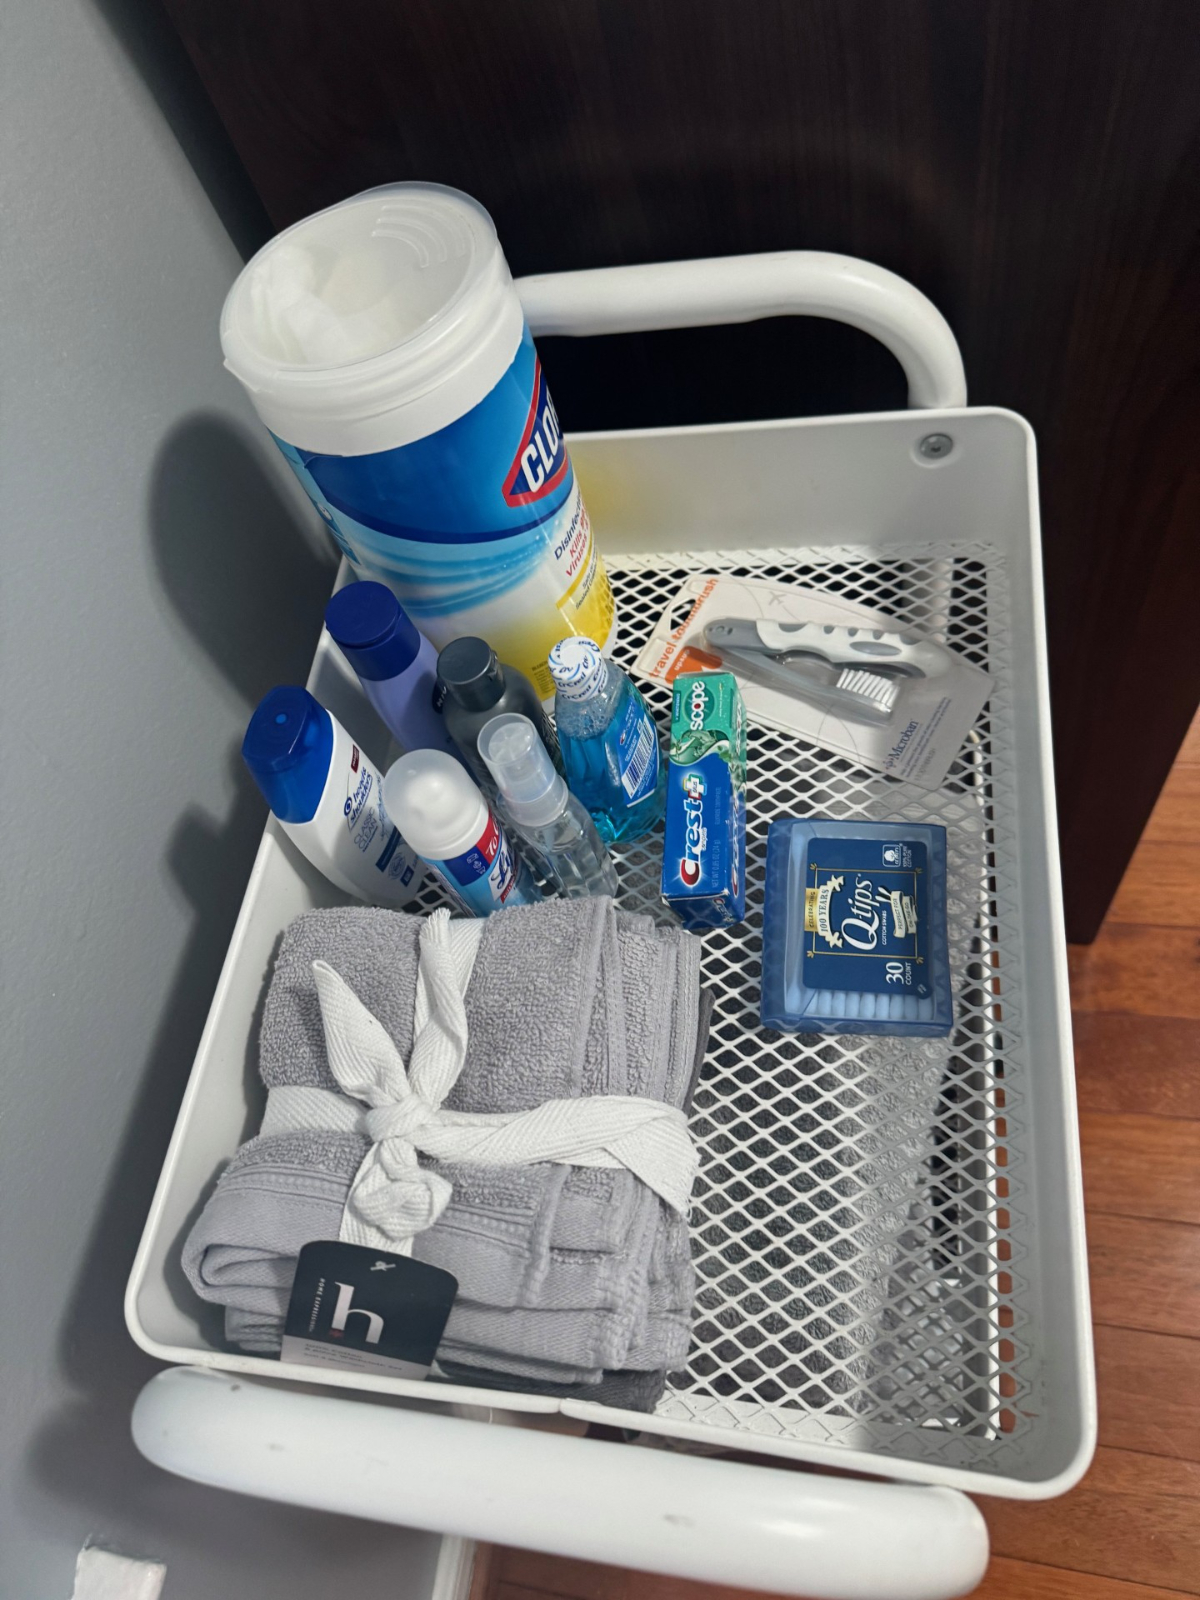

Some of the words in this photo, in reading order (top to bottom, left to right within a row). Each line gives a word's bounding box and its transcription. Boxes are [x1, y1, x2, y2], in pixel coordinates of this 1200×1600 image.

[569, 530, 582, 558] Kills
[649, 641, 677, 677] travel
[690, 681, 709, 730] scope
[888, 720, 919, 760] Microban
[354, 807, 375, 844] CLASSIC
[359, 817, 377, 849] CLEAN
[680, 796, 704, 886] Crest
[808, 891, 816, 928] CELEBRATING
[818, 889, 829, 916] YEARS
[841, 877, 880, 950] Q-tips
[894, 909, 903, 930] PERFECT
[819, 918, 829, 932] 100
[885, 961, 905, 985] 30
[904, 962, 912, 986] COUNT
[331, 1281, 385, 1344] h
